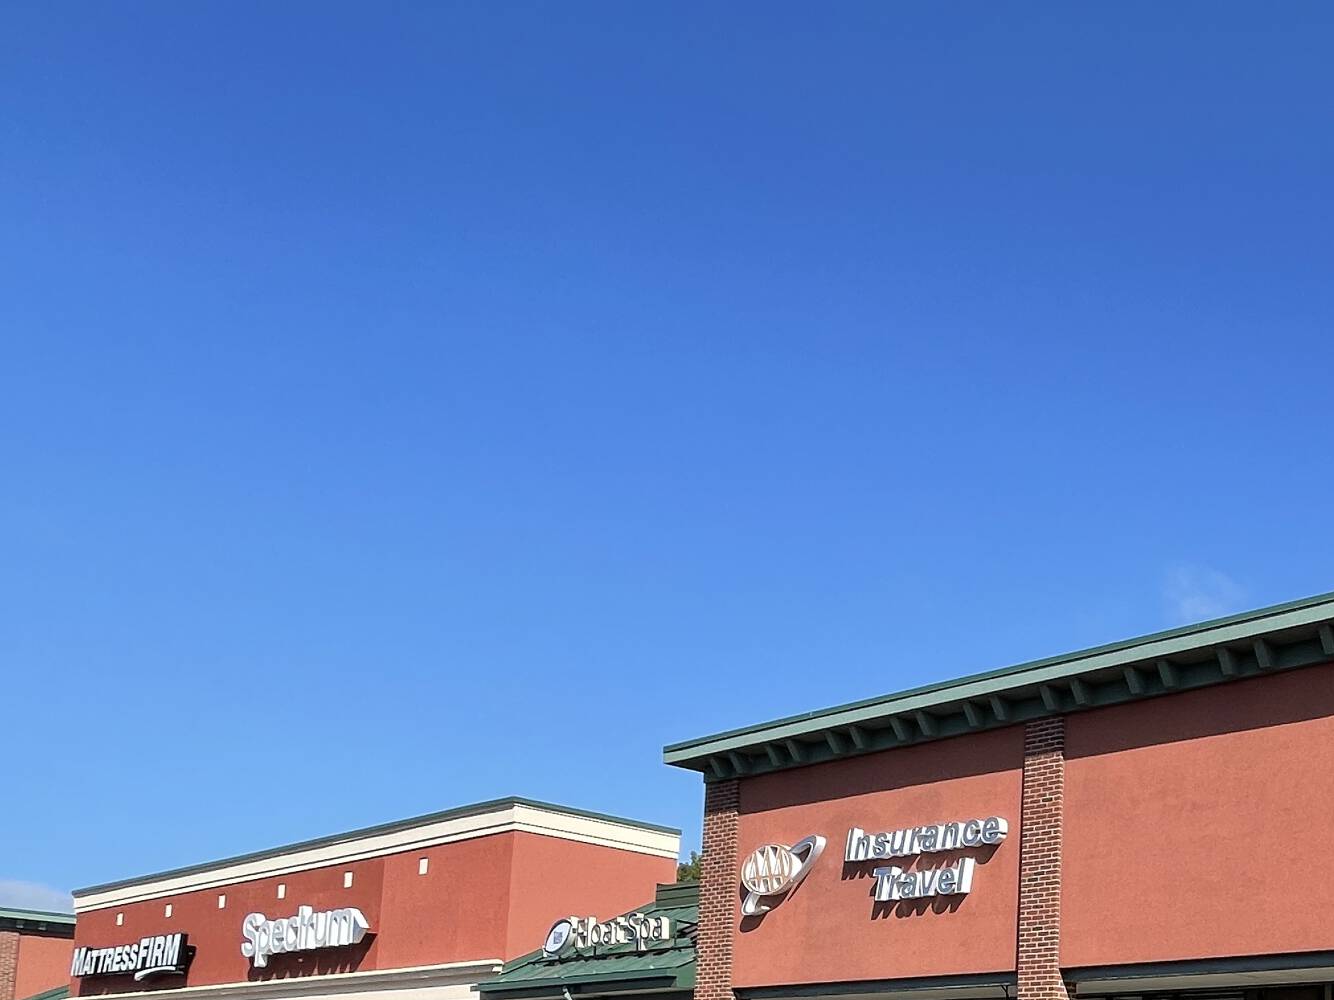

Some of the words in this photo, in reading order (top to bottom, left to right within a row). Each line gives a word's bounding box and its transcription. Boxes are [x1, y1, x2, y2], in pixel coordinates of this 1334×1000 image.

[846, 816, 1009, 862] Insurance
[748, 845, 793, 893] AAA
[873, 857, 977, 901] Travel
[241, 905, 369, 968] Spectrum
[627, 912, 670, 950] Spa
